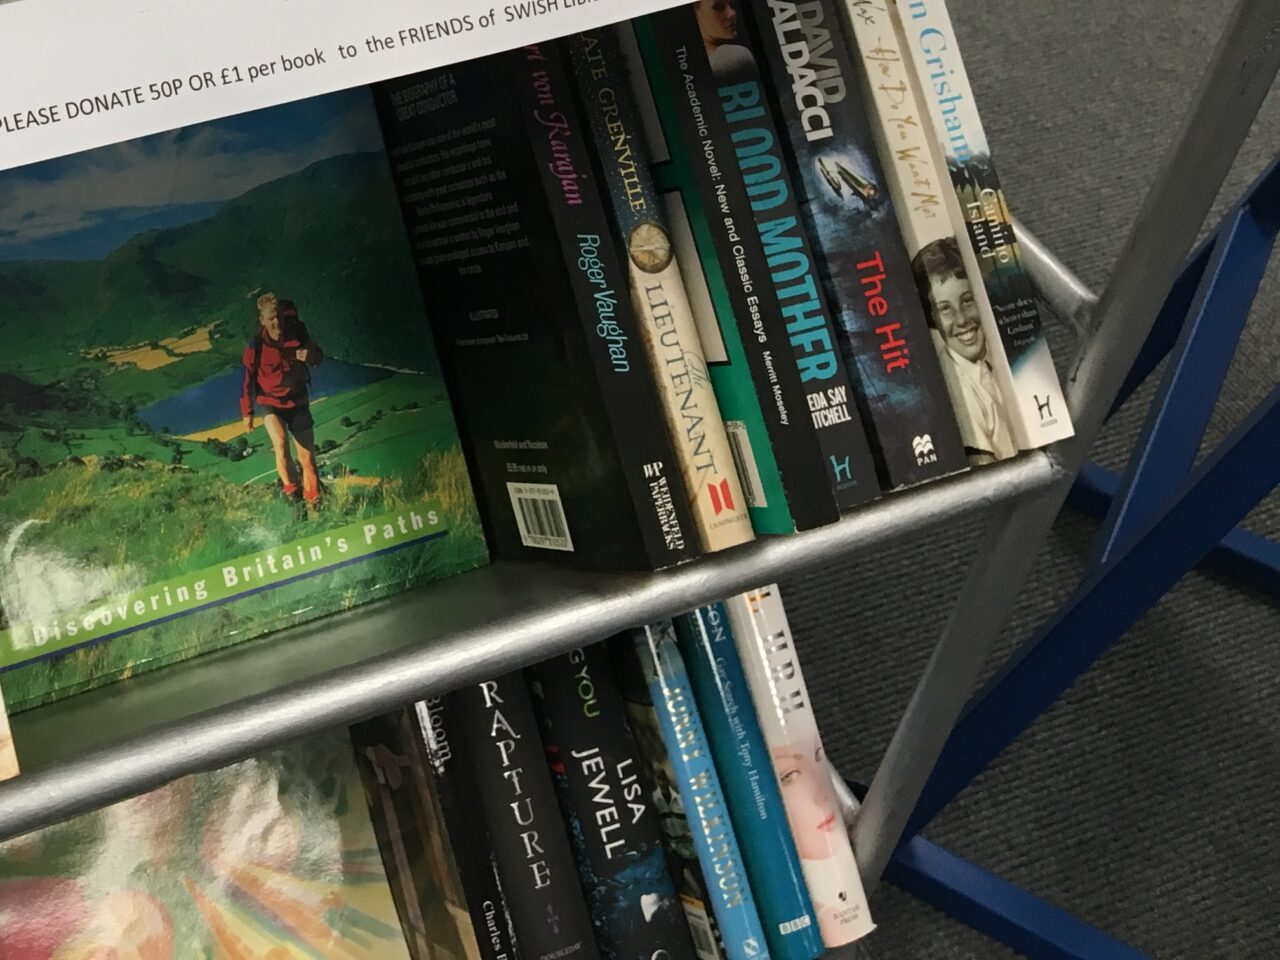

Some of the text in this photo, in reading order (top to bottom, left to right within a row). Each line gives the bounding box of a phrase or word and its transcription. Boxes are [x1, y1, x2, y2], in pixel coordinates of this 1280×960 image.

[65, 87, 145, 119] DONATE
[149, 80, 183, 101] 50P
[188, 72, 217, 93] OR
[220, 66, 242, 85] £1
[247, 59, 276, 87] per
[280, 47, 326, 73] book
[338, 43, 357, 60] to
[364, 34, 395, 55] the
[398, 14, 474, 47] FRIENDS
[478, 9, 497, 28] of
[798, 0, 846, 105] DAVID
[919, 27, 971, 166] Grisham
[599, 88, 647, 213] GRENVILLE
[531, 71, 630, 373] von Karajan Roger Vaughan
[675, 46, 790, 426] The Academic Novel: New and Classic Essays Merritt Moseley
[967, 202, 997, 259] Island
[979, 188, 1011, 264] Camino
[758, 215, 838, 383] MOTHER
[856, 250, 910, 374] The Hit
[645, 282, 718, 475] LIEUTENANT
[917, 453, 937, 467] PAN
[32, 506, 440, 647] Discovering Britain's Paths
[574, 669, 600, 719] YOU
[479, 680, 551, 890] RAPTURE
[571, 747, 625, 859] JEWELL
[616, 758, 647, 824] LISA
[748, 769, 768, 820] Hamilton
[482, 900, 501, 952] Charles
[780, 915, 811, 935] BBC
